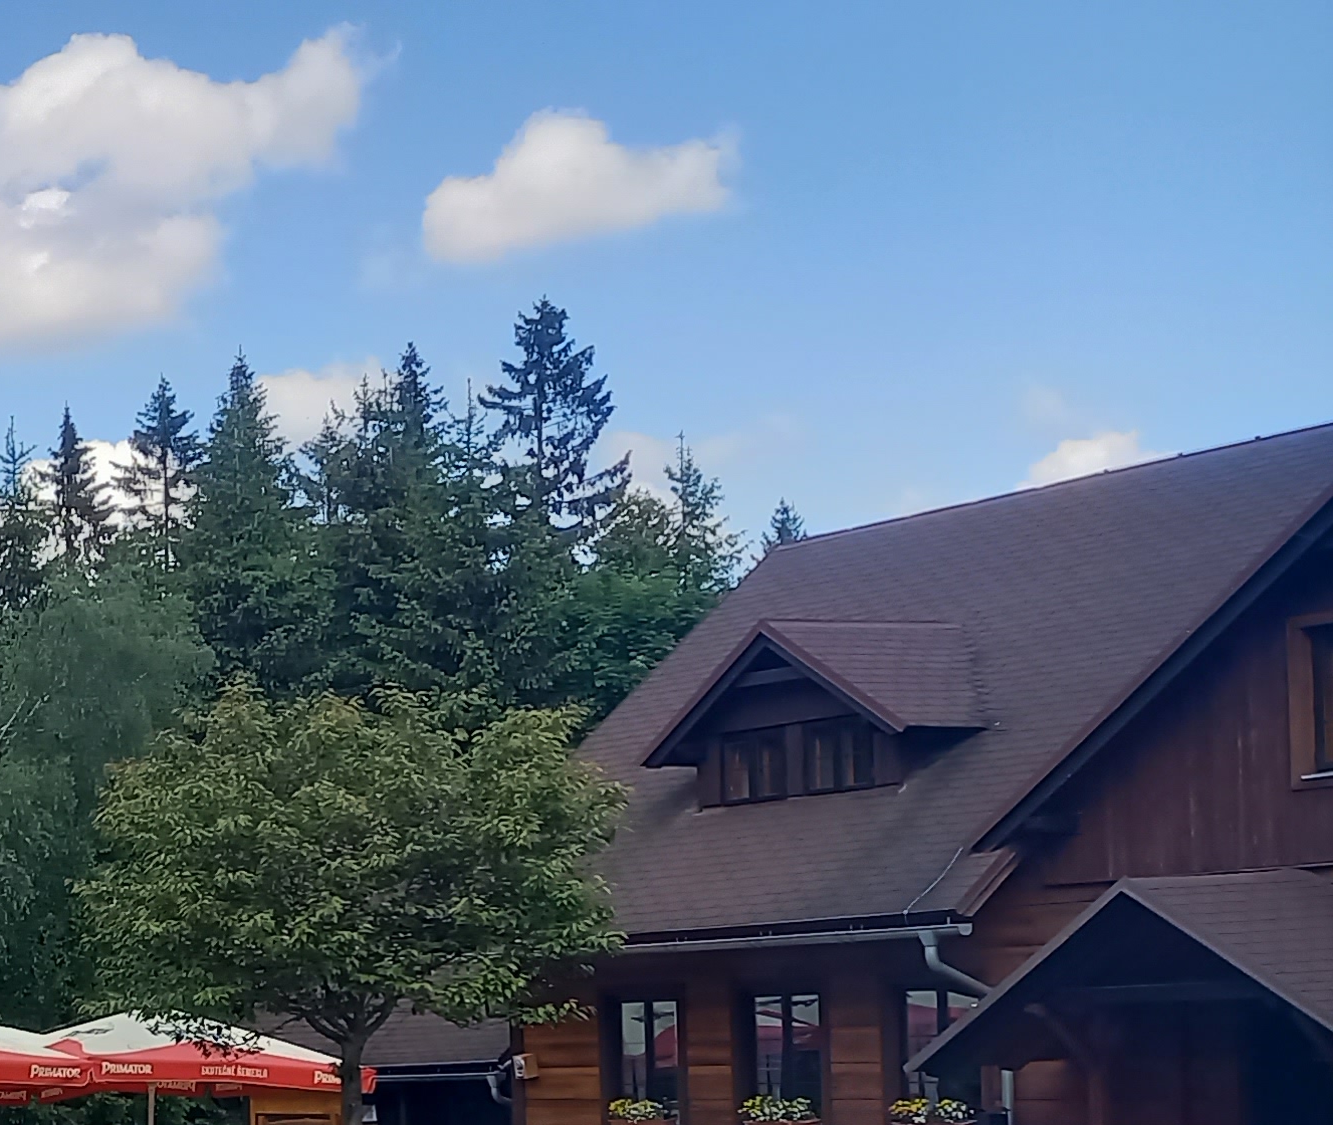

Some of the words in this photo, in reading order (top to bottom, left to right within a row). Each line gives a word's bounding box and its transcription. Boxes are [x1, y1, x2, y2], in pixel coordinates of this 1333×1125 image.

[30, 1064, 81, 1079] PRIMATOR
[101, 1061, 153, 1075] PRIMATOR
[313, 1070, 342, 1085] PRIM
